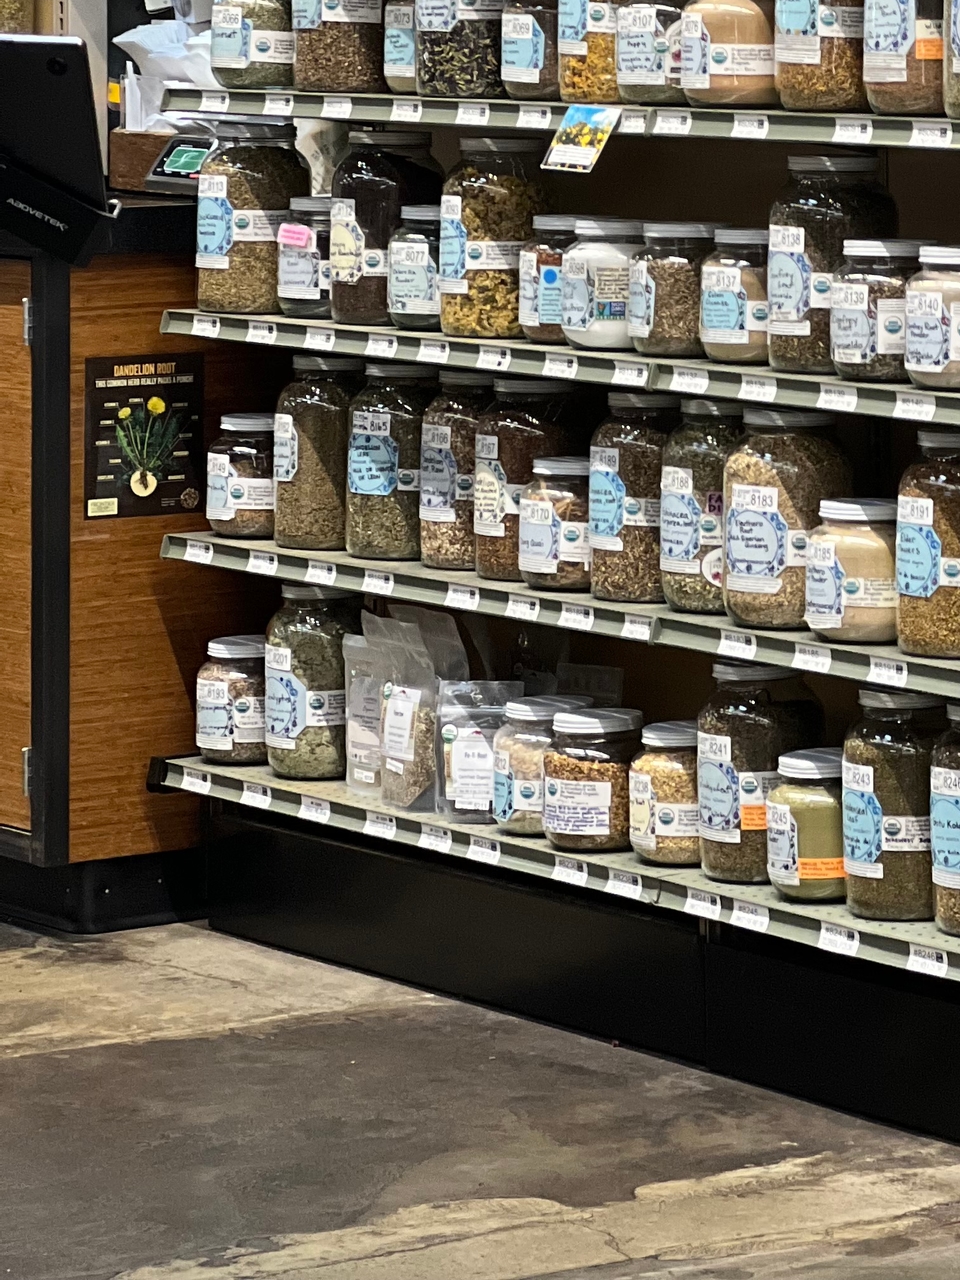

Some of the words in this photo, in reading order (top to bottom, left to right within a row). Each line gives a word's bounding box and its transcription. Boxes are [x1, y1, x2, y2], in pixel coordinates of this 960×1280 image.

[512, 21, 530, 33] 8069
[632, 15, 652, 27] 8107
[207, 181, 224, 192] 8113
[6, 197, 66, 232] ABOVETEK
[781, 232, 801, 245] 8138
[405, 250, 425, 262] 8077
[716, 275, 736, 287] 8137
[844, 293, 865, 304] 8139
[918, 298, 938, 312] 8140
[114, 364, 155, 377] DANDELION
[157, 363, 176, 373] ROOT
[128, 378, 140, 386] HERB
[141, 377, 157, 385] REALLY
[370, 421, 388, 431] 8165
[431, 432, 449, 444] 8166
[481, 443, 495, 455] 8167
[671, 475, 689, 487] 8188
[749, 495, 774, 507] 8183
[530, 507, 550, 519] 8170
[910, 506, 930, 519] 8191
[813, 548, 831, 560] 8185
[272, 652, 288, 665] 8201
[207, 689, 225, 700] 8193
[709, 742, 727, 755] 8241
[852, 772, 871, 784] 8243
[772, 813, 787, 824] 8245
[912, 948, 936, 961] #8246
